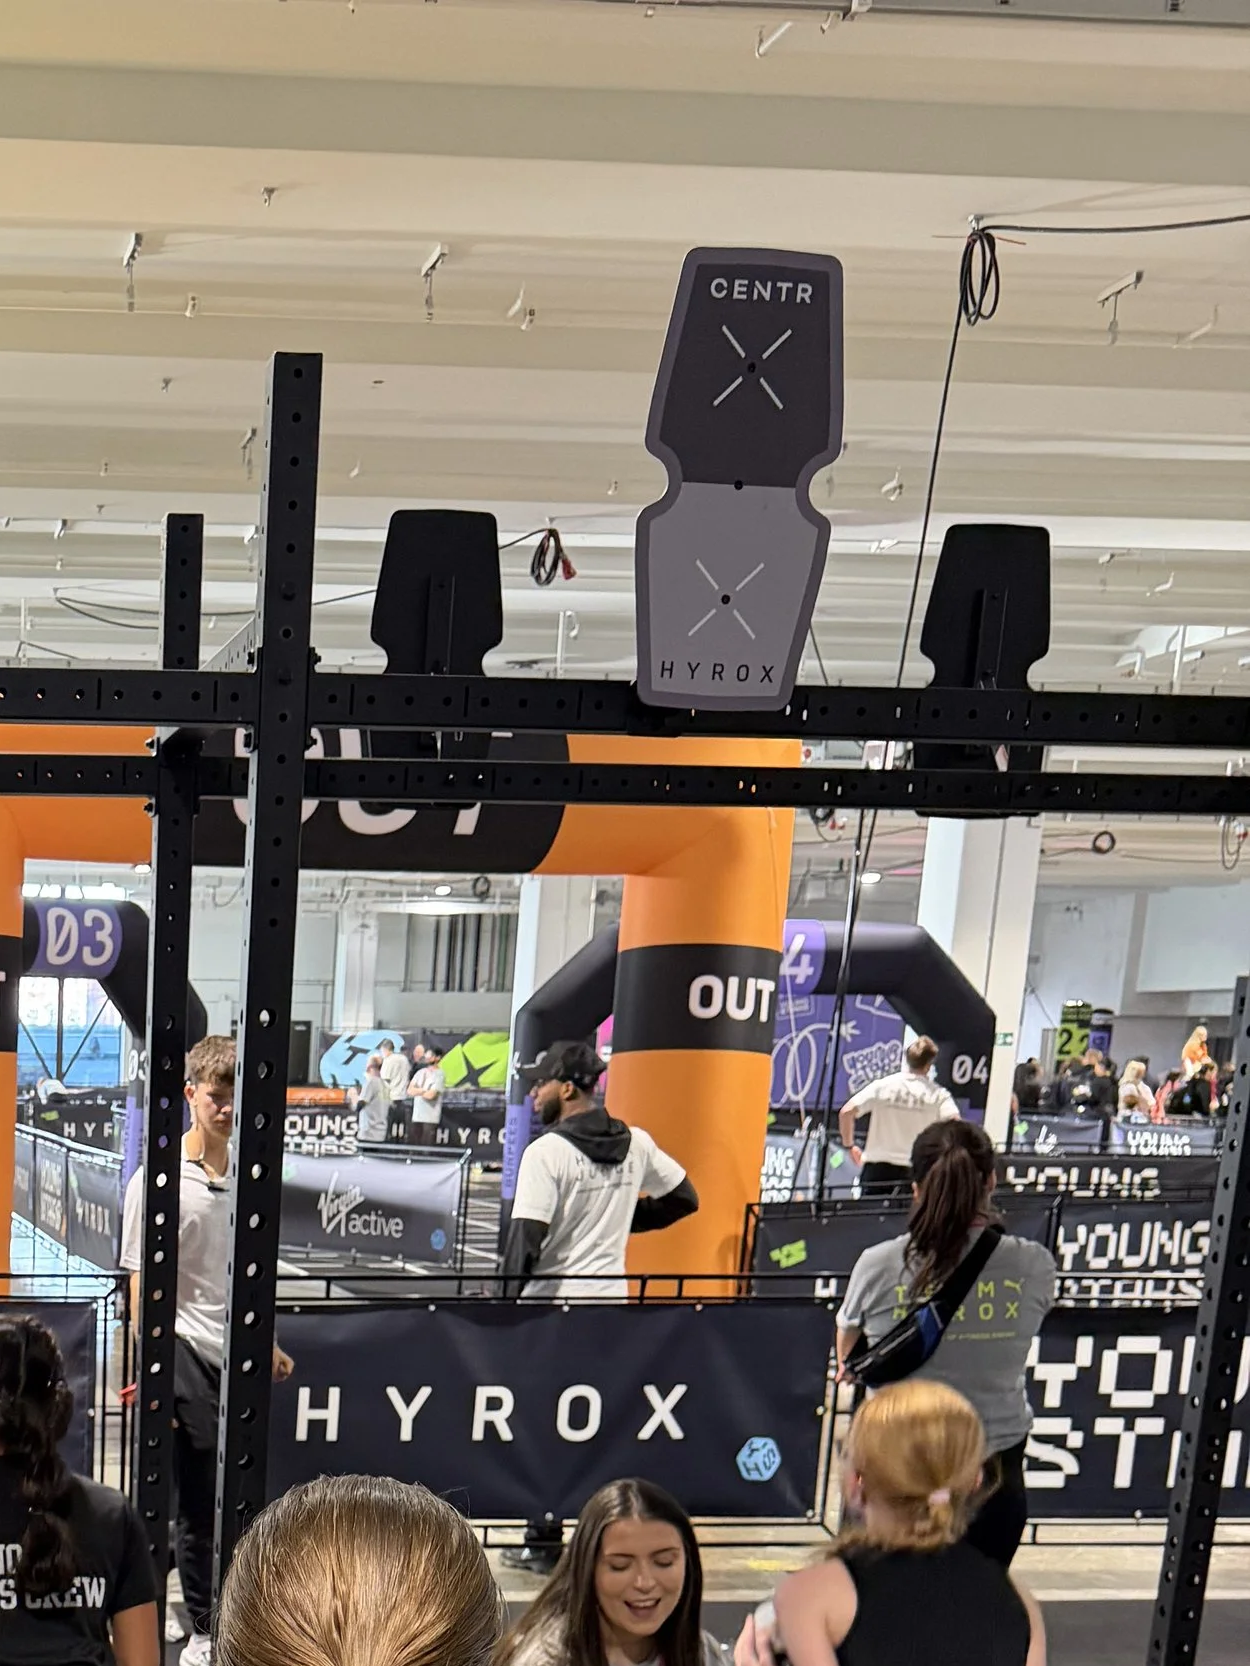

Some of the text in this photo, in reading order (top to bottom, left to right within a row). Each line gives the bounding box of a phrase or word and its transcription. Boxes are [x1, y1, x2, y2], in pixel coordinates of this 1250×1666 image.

[710, 277, 814, 305] CENTR
[660, 659, 775, 684] HYROX
[46, 907, 114, 967] 03
[688, 974, 776, 1023] OUT
[952, 1054, 990, 1085] 04
[284, 1114, 358, 1136] OUNG
[348, 1209, 404, 1238] active
[1057, 1219, 1211, 1271] YOUNG
[891, 1301, 1019, 1322] HROX
[295, 1383, 688, 1443] HYROX
